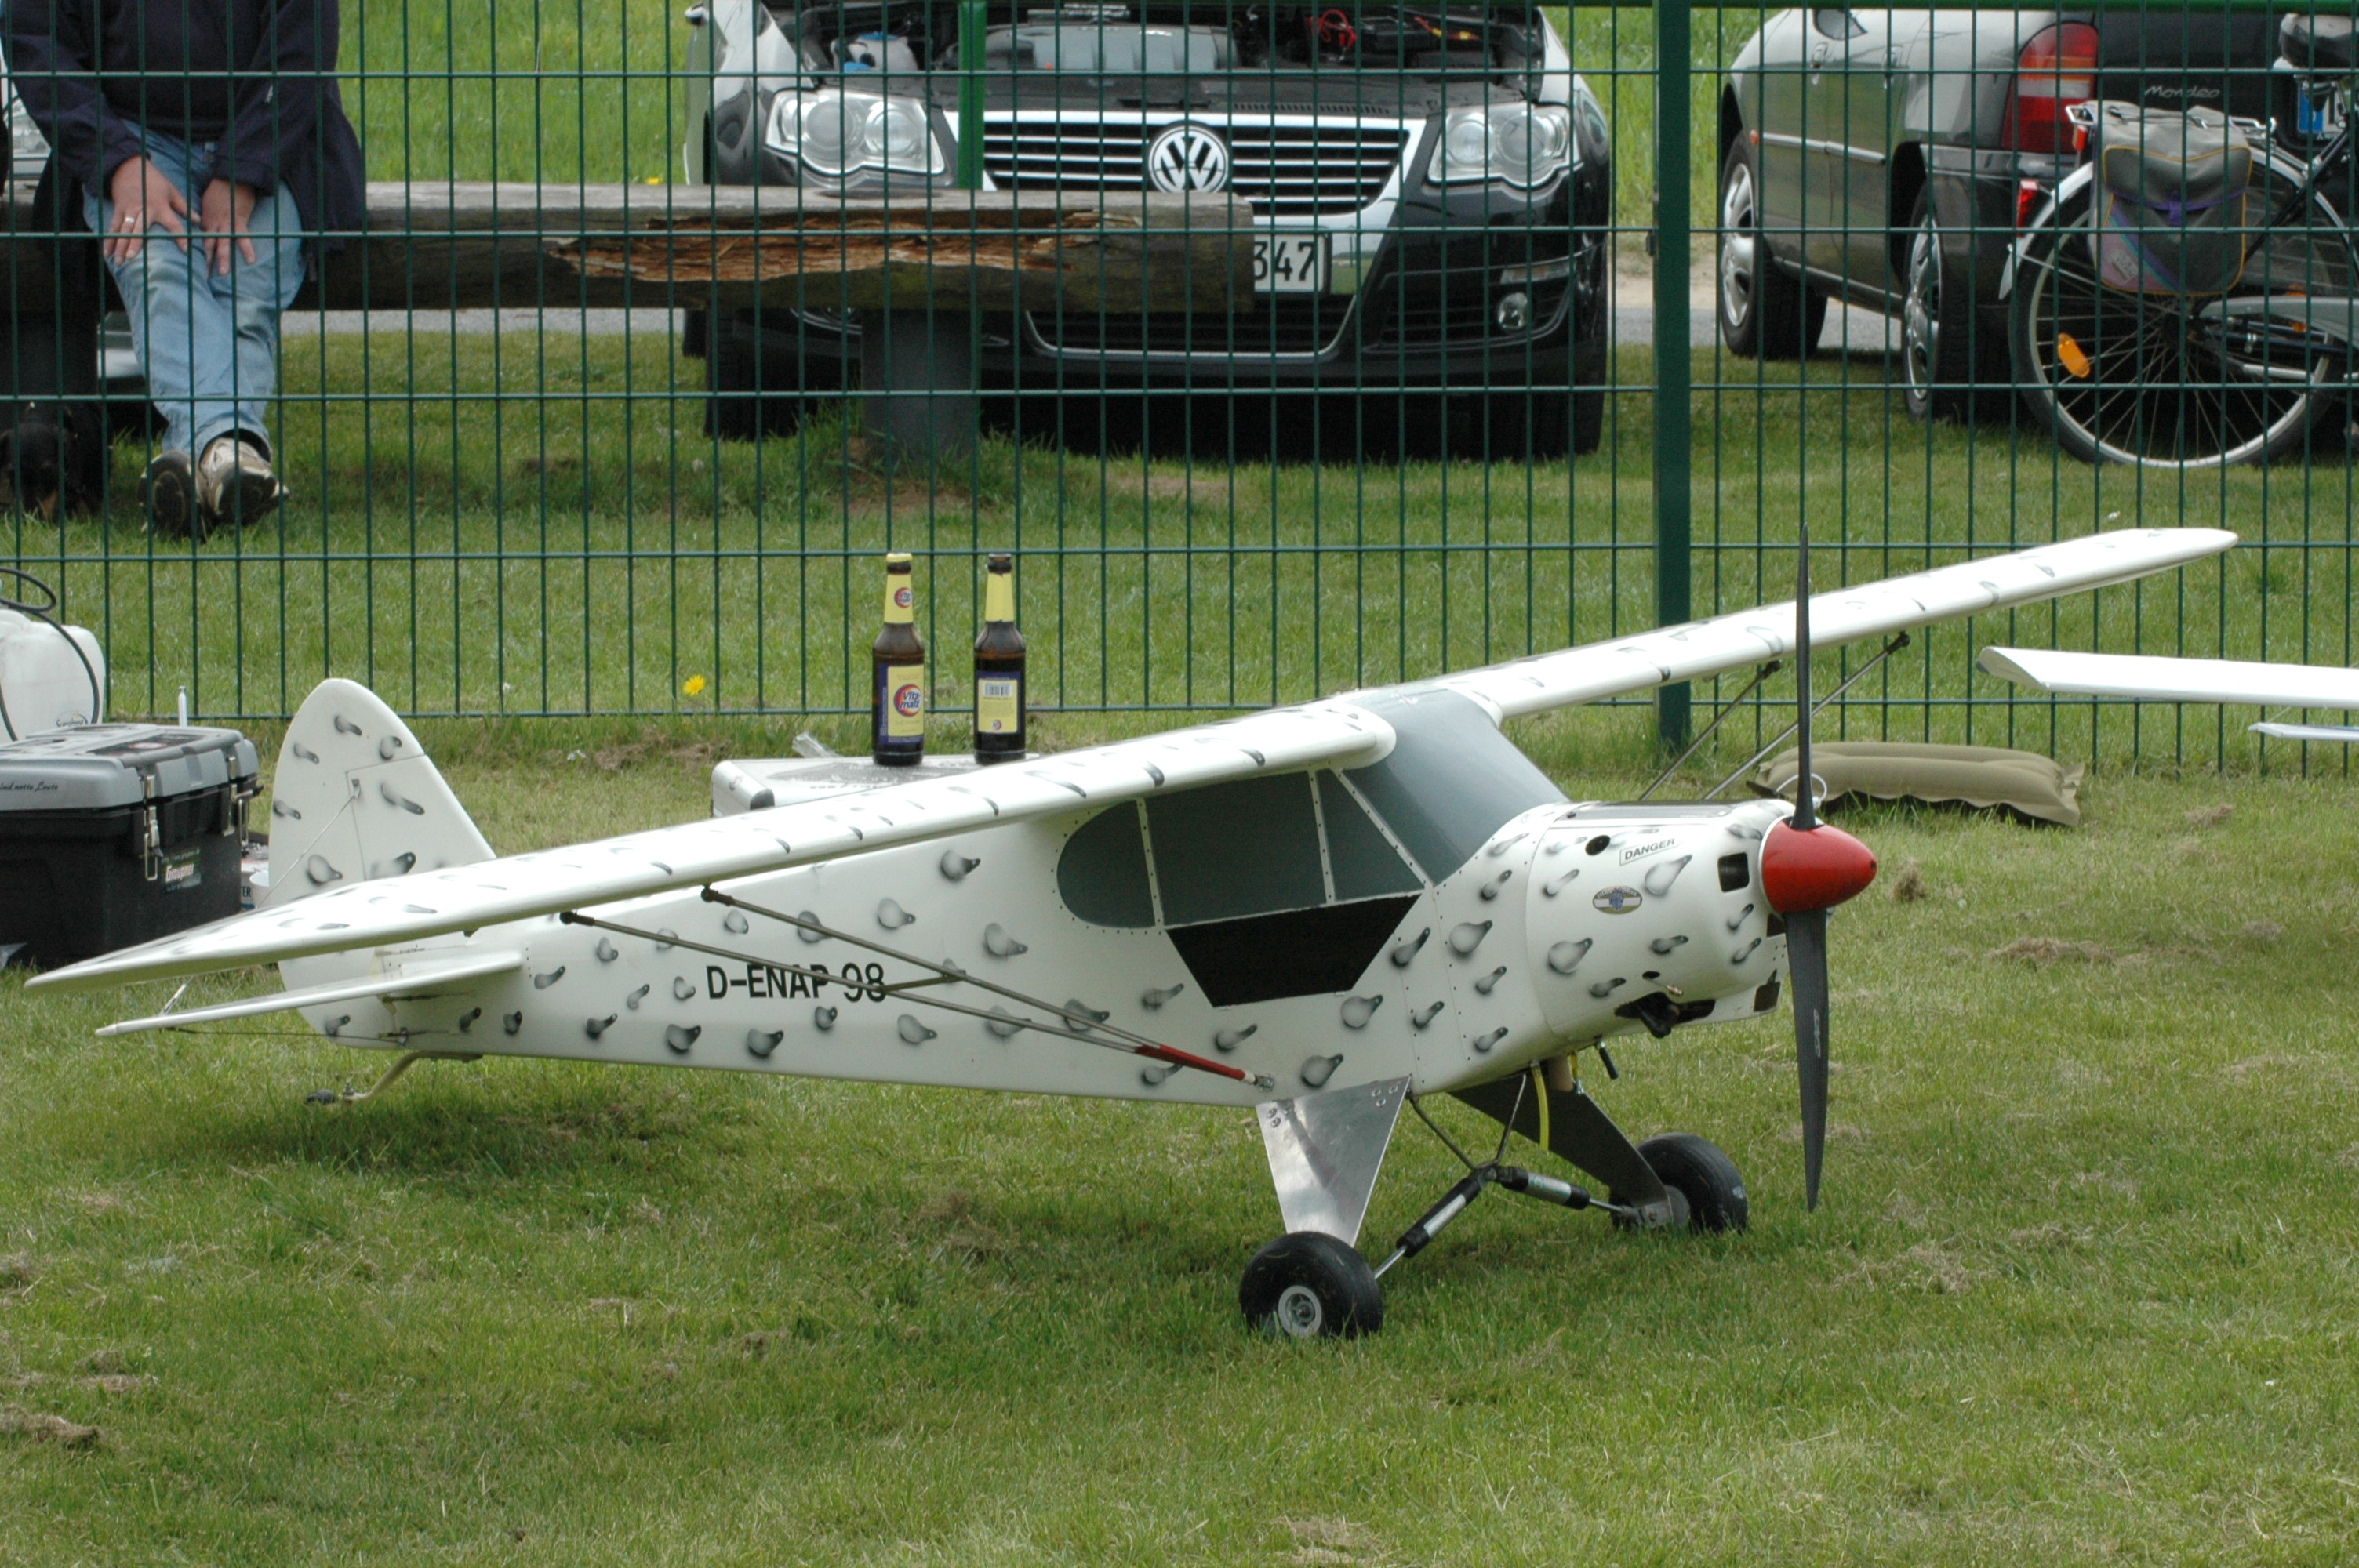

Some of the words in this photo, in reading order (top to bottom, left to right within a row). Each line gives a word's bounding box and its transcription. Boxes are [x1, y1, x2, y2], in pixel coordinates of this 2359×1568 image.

[2144, 85, 2220, 98] Mondeo
[0, 782, 14, 790] ind
[1625, 838, 1674, 860] DANGER
[841, 963, 887, 1003] 98
